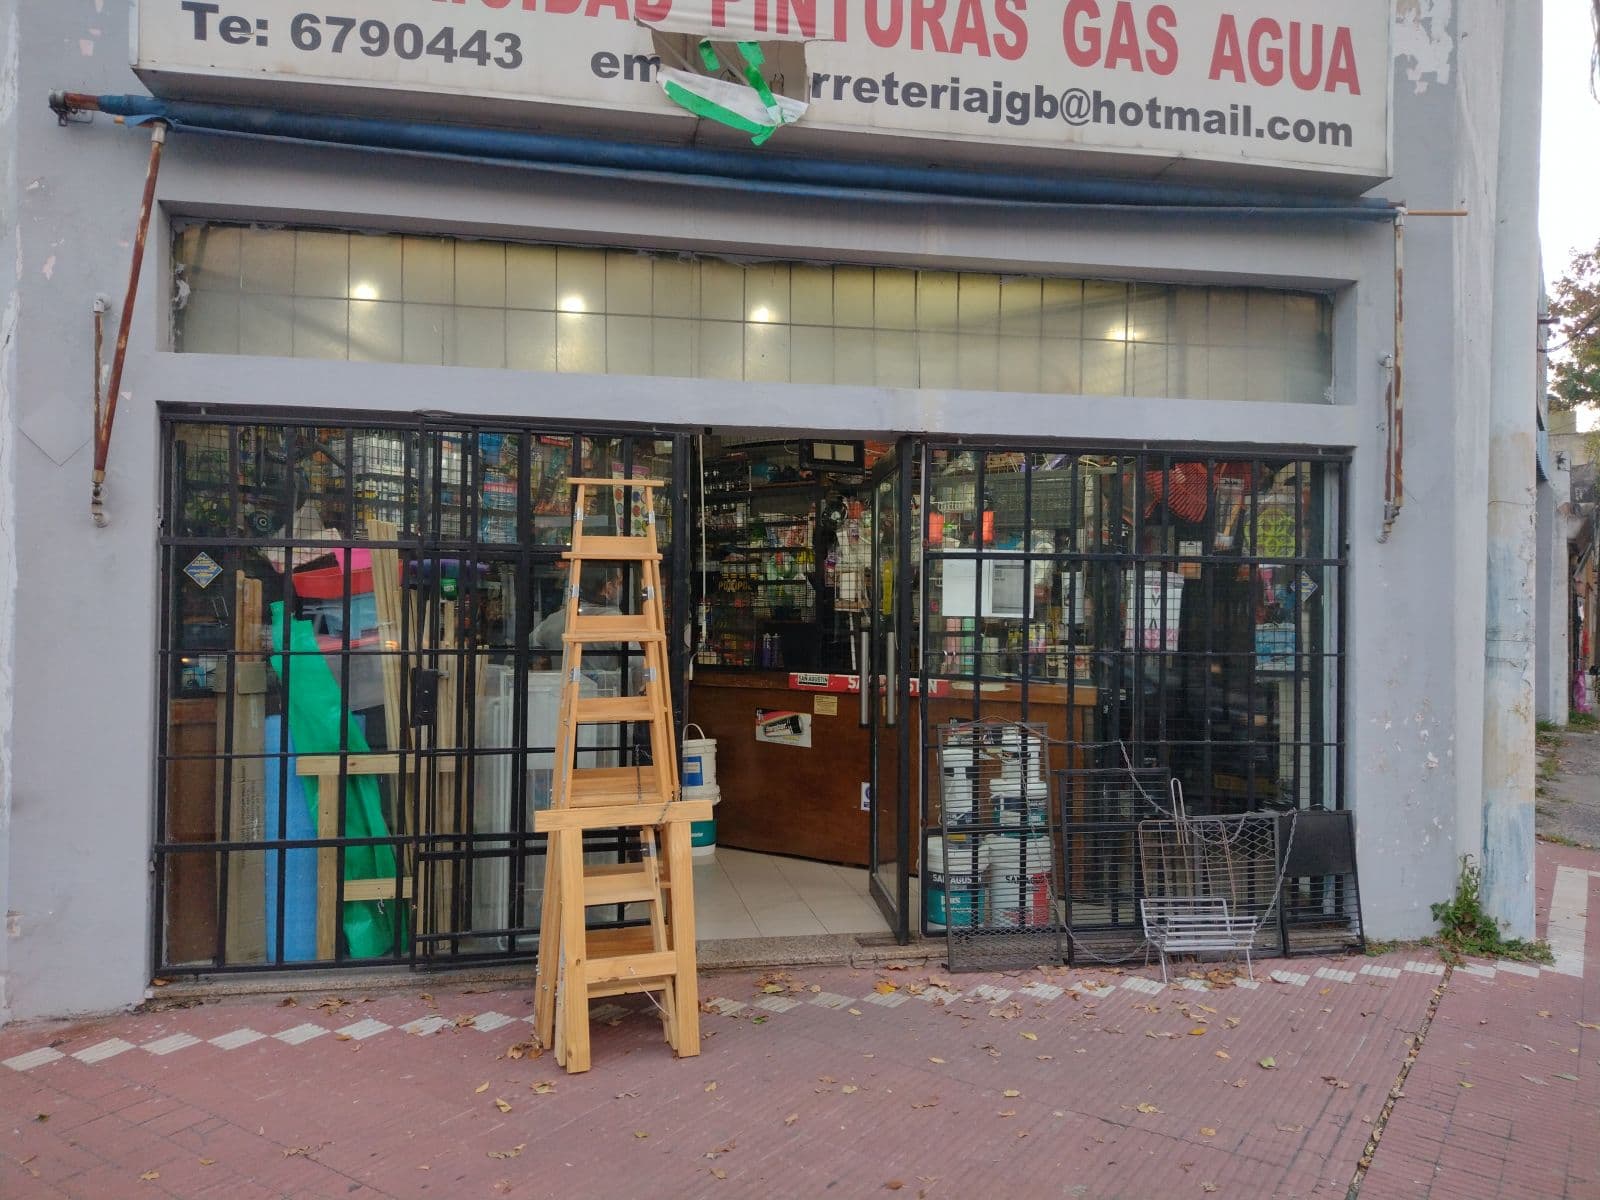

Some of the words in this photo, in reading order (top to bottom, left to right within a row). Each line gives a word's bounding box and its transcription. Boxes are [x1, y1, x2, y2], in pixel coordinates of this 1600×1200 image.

[181, 0, 269, 47] Te:
[290, 13, 523, 70] 6790443
[1062, 0, 1179, 76] GAS
[1208, 13, 1362, 96] AGUA
